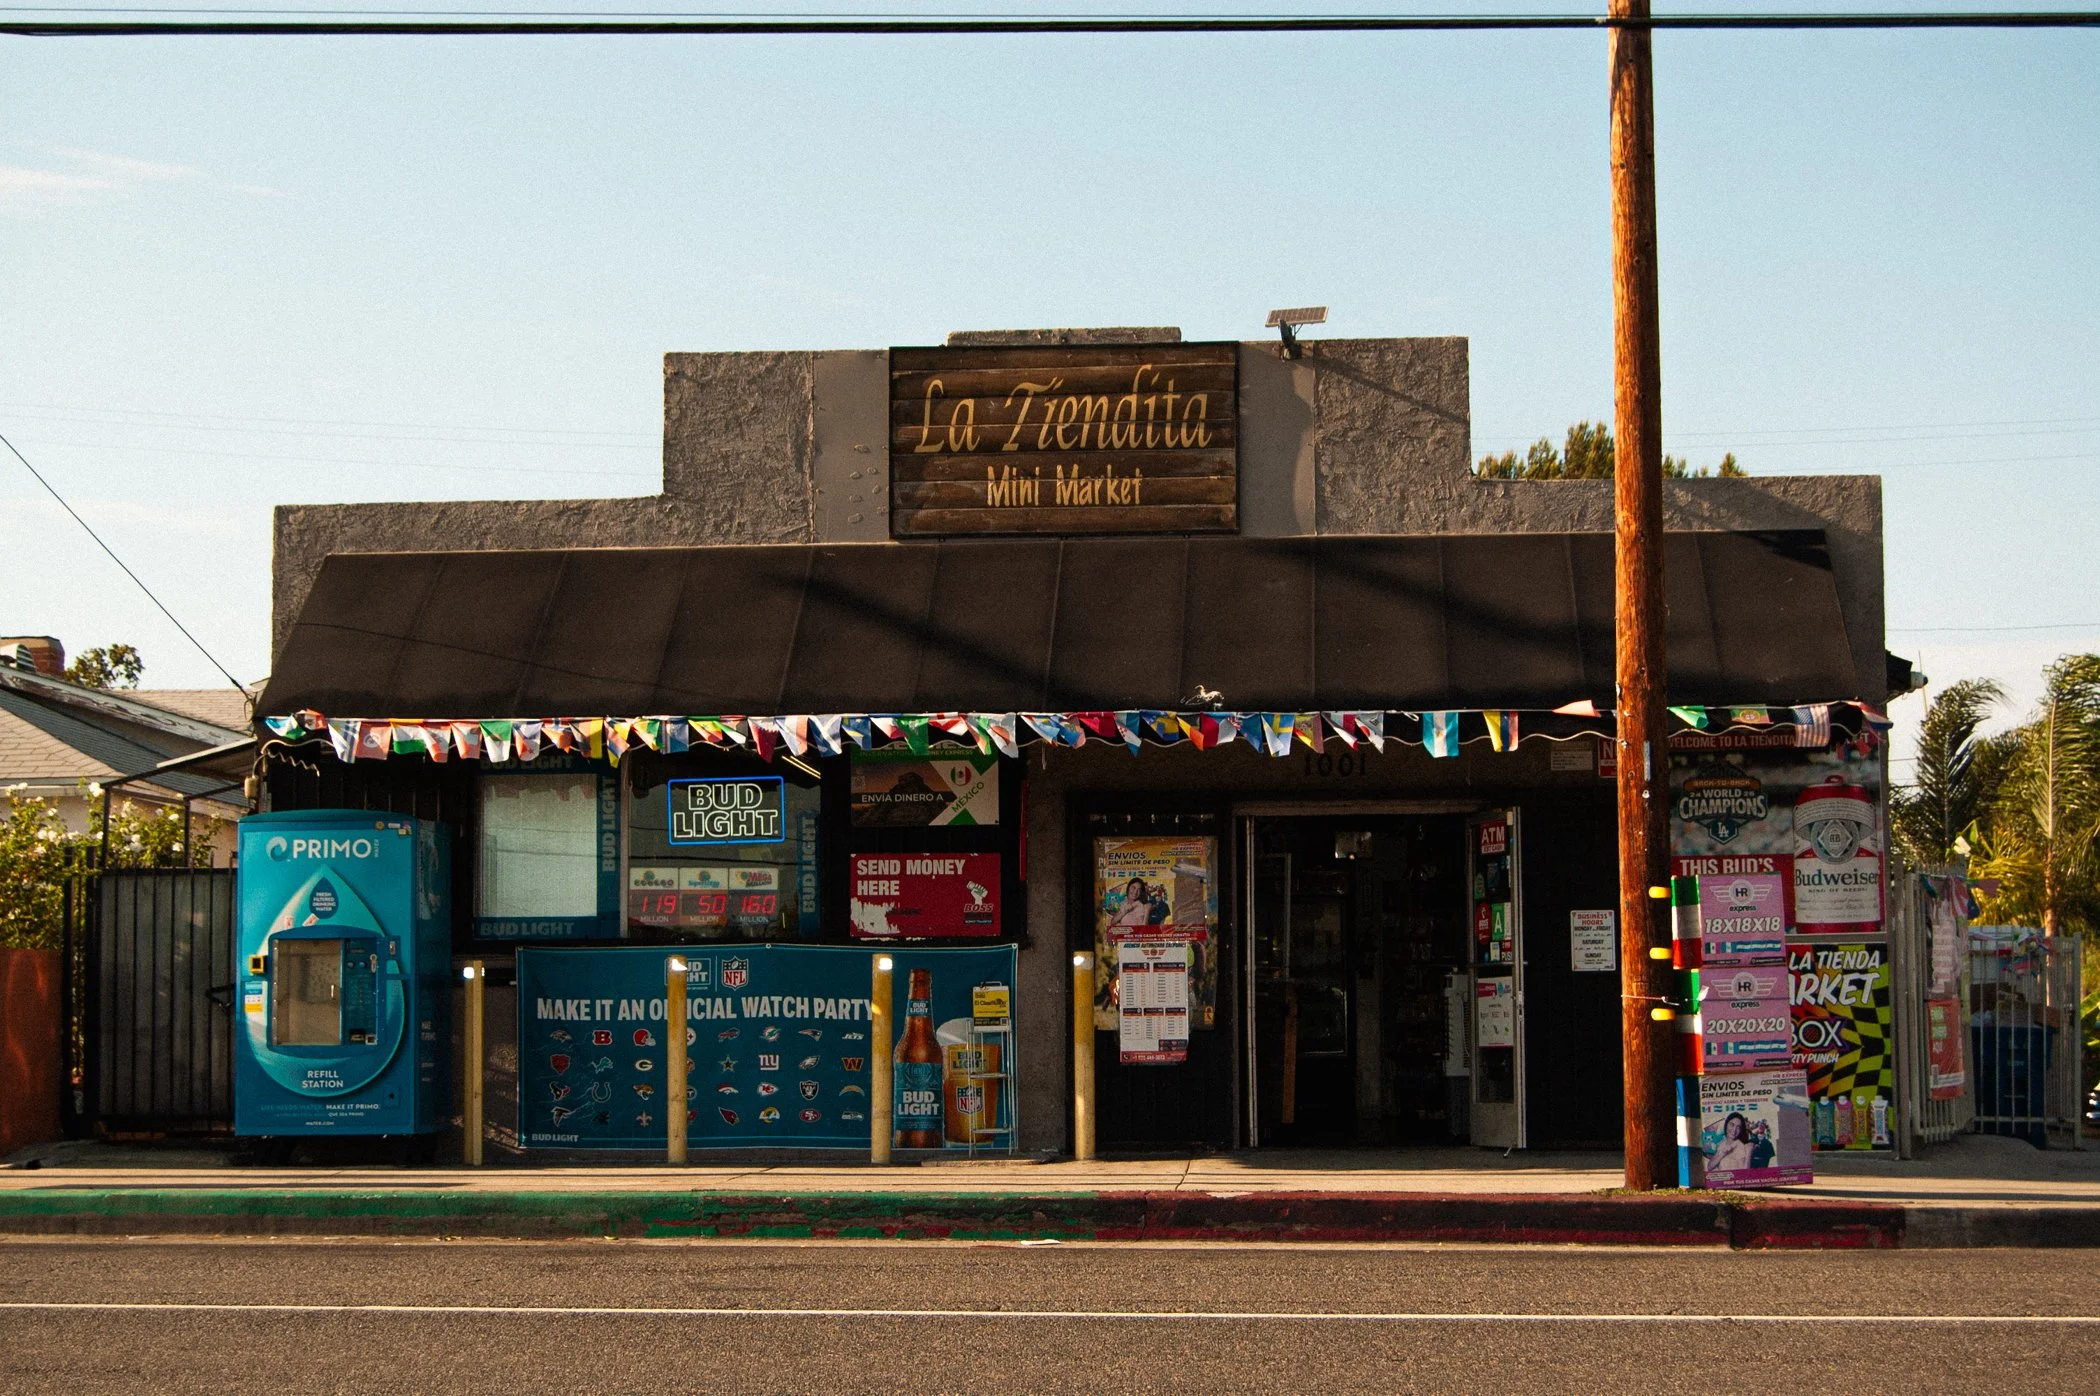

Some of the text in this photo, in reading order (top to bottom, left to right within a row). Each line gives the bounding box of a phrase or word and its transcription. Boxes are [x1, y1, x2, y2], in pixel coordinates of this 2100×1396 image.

[914, 364, 1213, 454] La Tiendita
[987, 464, 1143, 507] Mini Market
[1719, 736, 1729, 747] TO
[1734, 735, 1747, 747] LA
[1304, 752, 1367, 777] 1001
[687, 783, 763, 811] BUD
[894, 793, 934, 802] DINERO
[935, 793, 944, 801] A
[1702, 788, 1741, 798] WORLD
[1679, 795, 1767, 819] CHAMPIONS
[602, 776, 616, 872] BUD LIGHT
[673, 809, 779, 838] LIGHT
[1482, 827, 1504, 844] ATM
[292, 838, 372, 859] PRIMO
[1108, 852, 1146, 860] ENVIOS
[802, 816, 816, 913] BUD LIGHT
[857, 858, 966, 876] SEND MONEY
[1680, 858, 1719, 875] THIS
[1795, 868, 1878, 887] Budweiser
[857, 879, 900, 896] HERE
[1735, 887, 1748, 898] HR
[699, 895, 727, 914] 50
[741, 895, 777, 914] 160
[963, 903, 994, 912] BOSS
[1729, 905, 1757, 913] express
[479, 921, 575, 936] BUD LIGHT
[1494, 911, 1503, 933] A
[1705, 917, 1781, 934] 18X18X18
[1788, 951, 1811, 970] LA
[1816, 950, 1880, 970] TIENDA
[724, 970, 746, 986] NFL
[1737, 982, 1752, 992] HR
[536, 997, 591, 1021] MAKE
[595, 997, 613, 1021] IT
[617, 997, 645, 1021] AN
[741, 995, 810, 1020] WATCH
[813, 997, 872, 1021] PARTY
[1730, 1001, 1760, 1009] express
[1706, 1017, 1786, 1034] 20X20X20
[1807, 1053, 1840, 1063] PUNCH
[307, 1070, 339, 1078] REFILL
[301, 1080, 344, 1089] STATION
[1701, 1081, 1745, 1092] ENVIOS
[902, 1090, 935, 1104] BUD
[897, 1103, 940, 1116] LIGHT
[531, 1133, 579, 1142] BUD LIGHT
